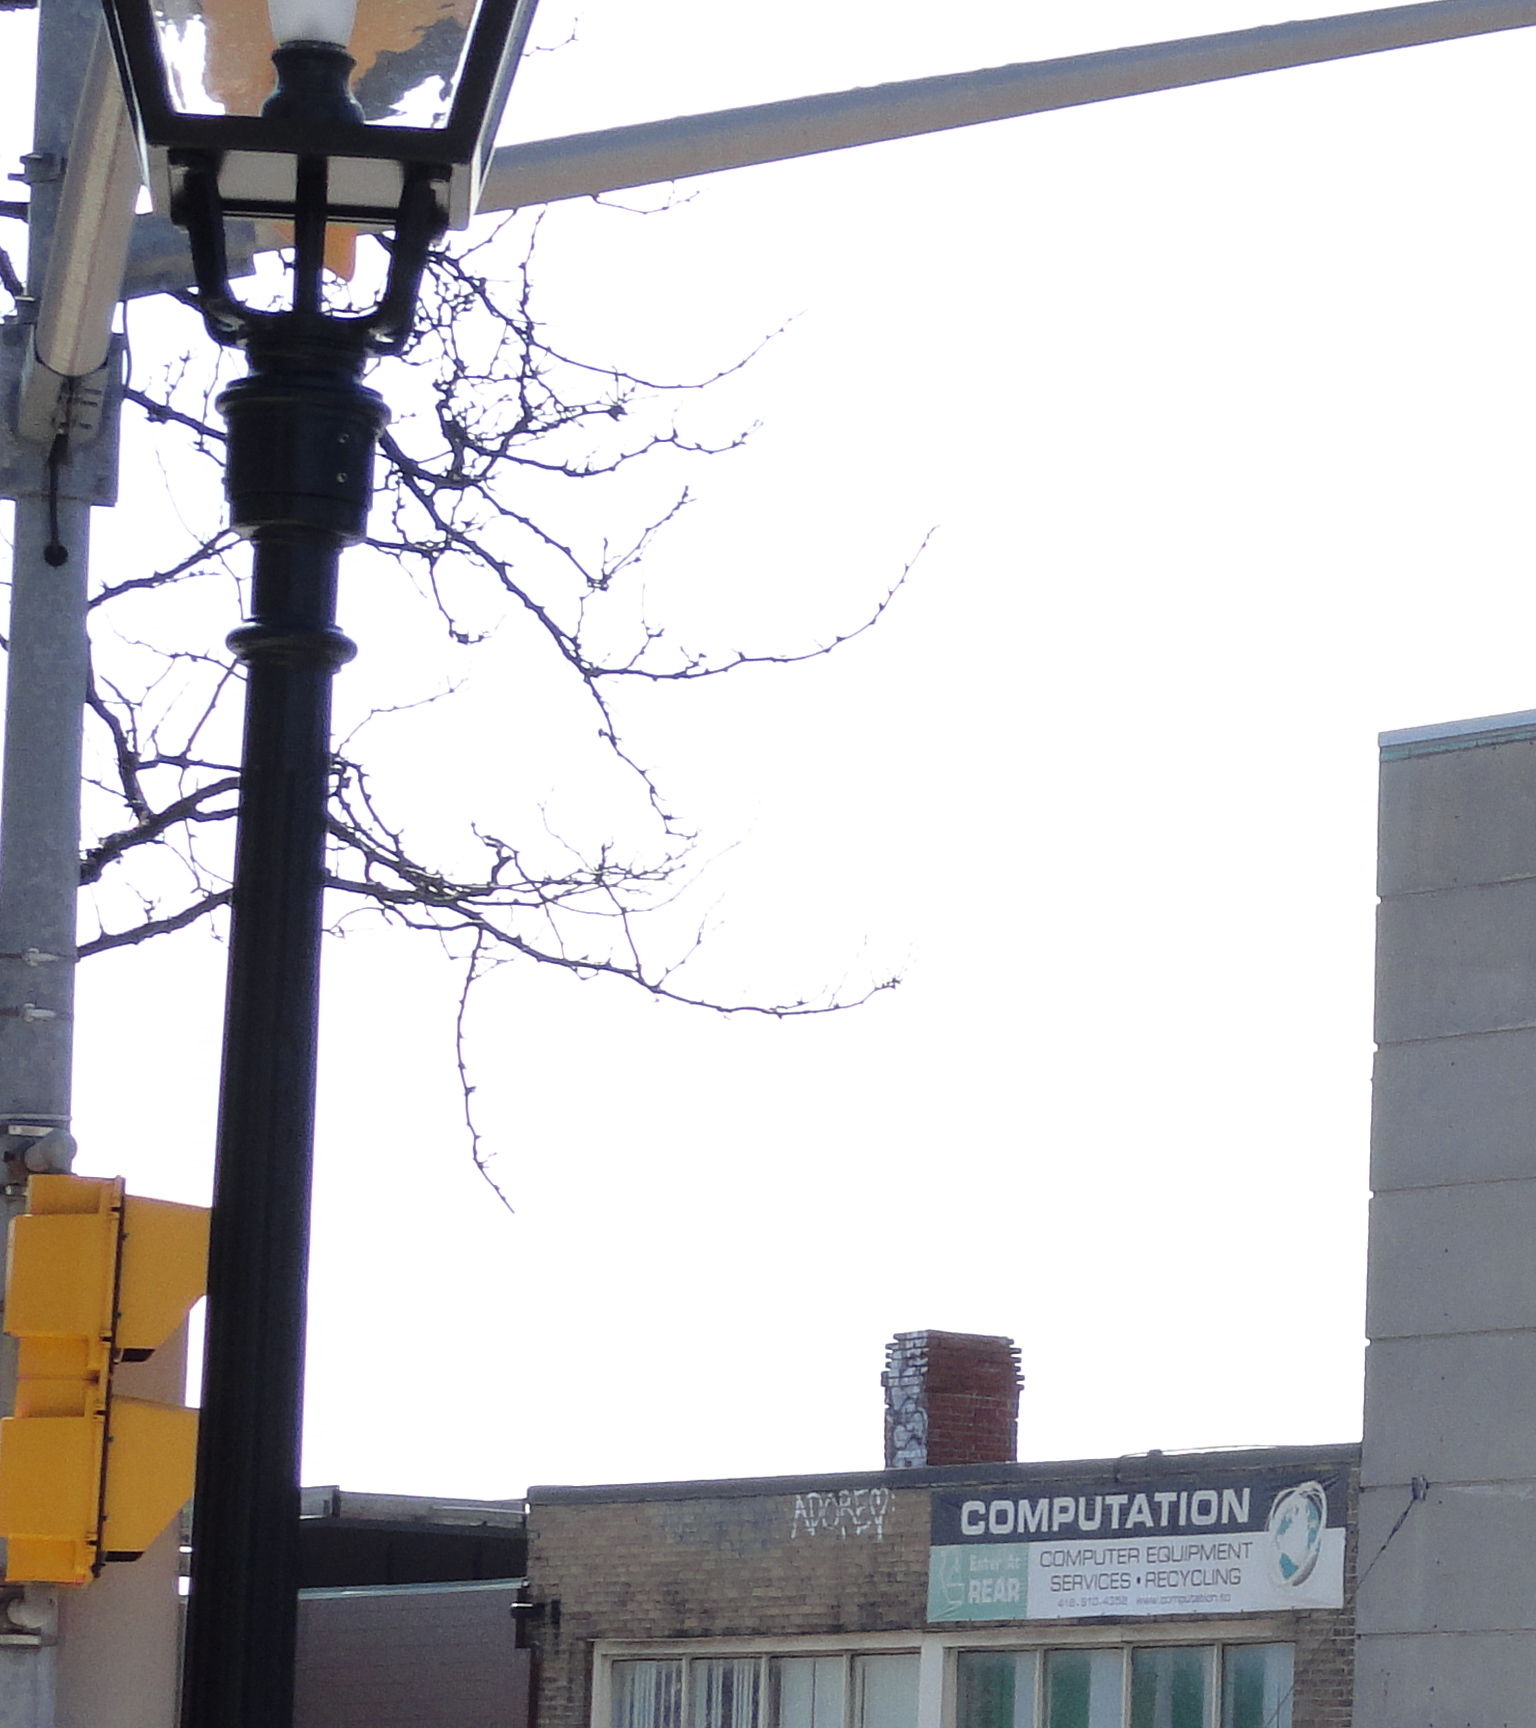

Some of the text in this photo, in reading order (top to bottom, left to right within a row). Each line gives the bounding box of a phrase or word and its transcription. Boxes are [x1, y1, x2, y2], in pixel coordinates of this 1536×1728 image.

[960, 1487, 1251, 1536] COMPUTATION
[1039, 1541, 1254, 1568] COMPUTER EQUIPMENT
[967, 1577, 1020, 1604] REAR
[1050, 1567, 1242, 1593] SERVICES RECYCLING
